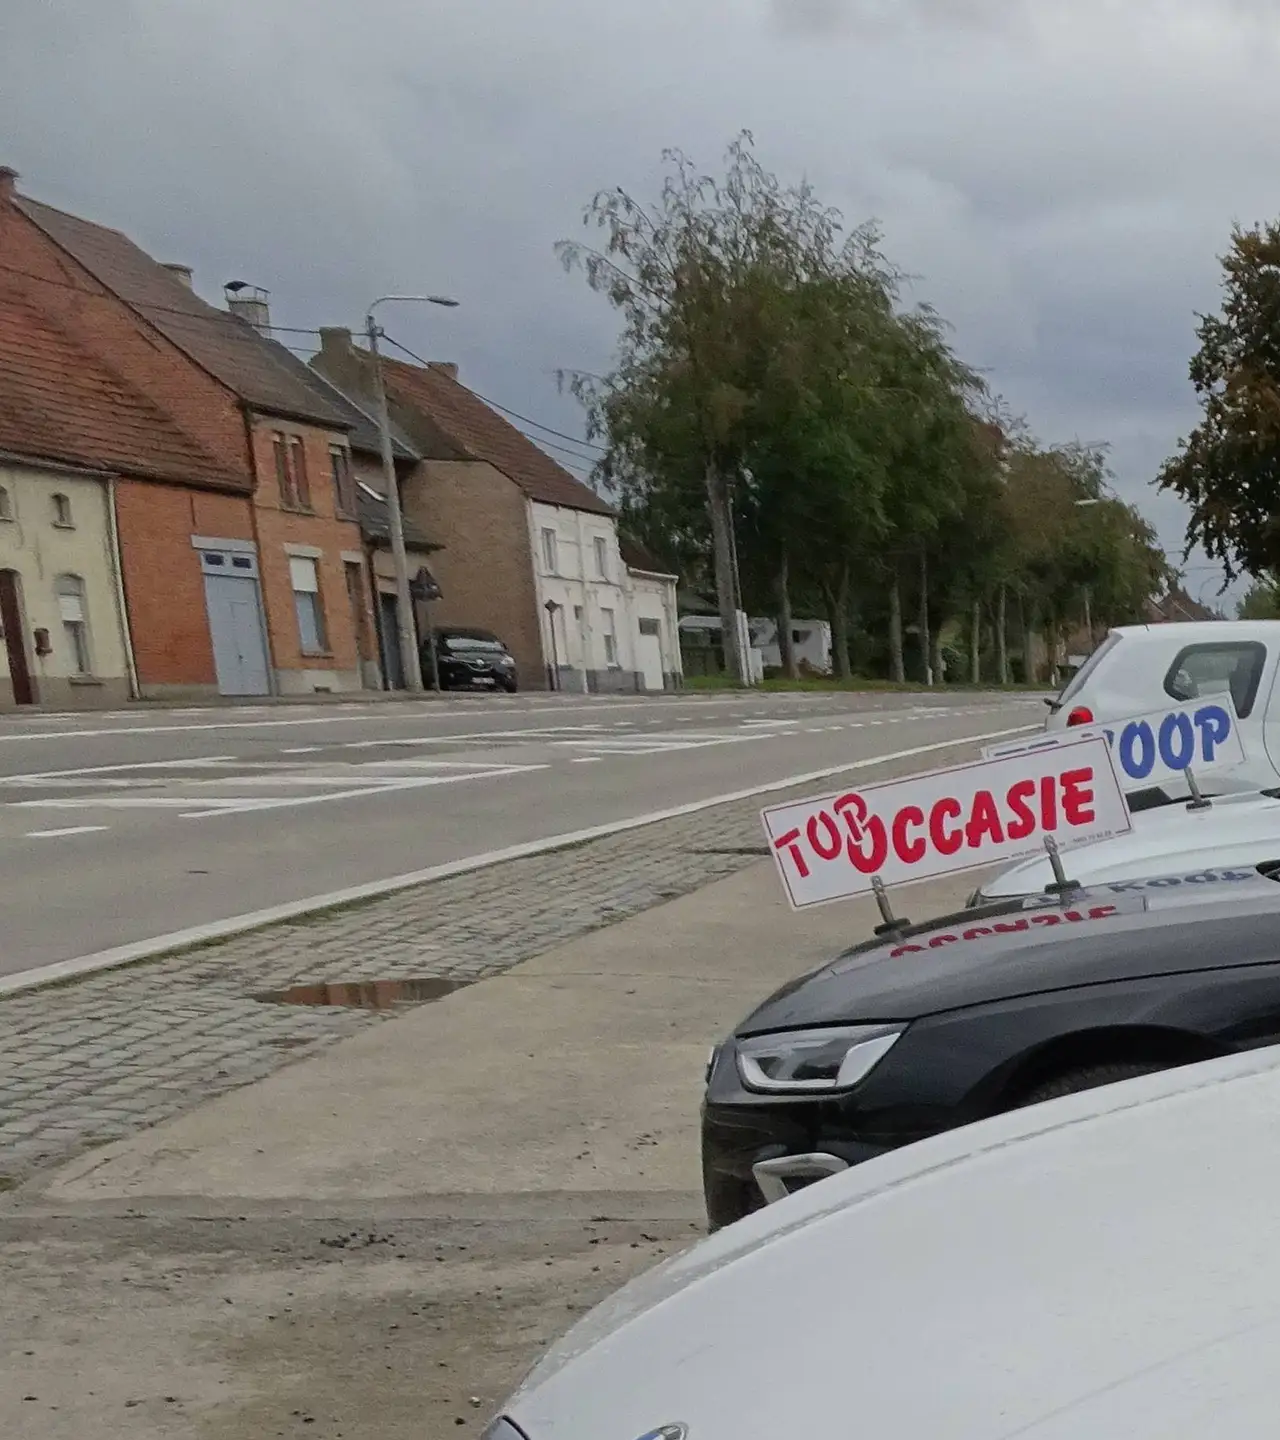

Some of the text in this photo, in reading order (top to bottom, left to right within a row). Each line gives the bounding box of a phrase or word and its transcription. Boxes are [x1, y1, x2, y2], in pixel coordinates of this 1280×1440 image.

[1100, 704, 1232, 780] OOP
[774, 766, 1096, 878] TOP OCCASIE
